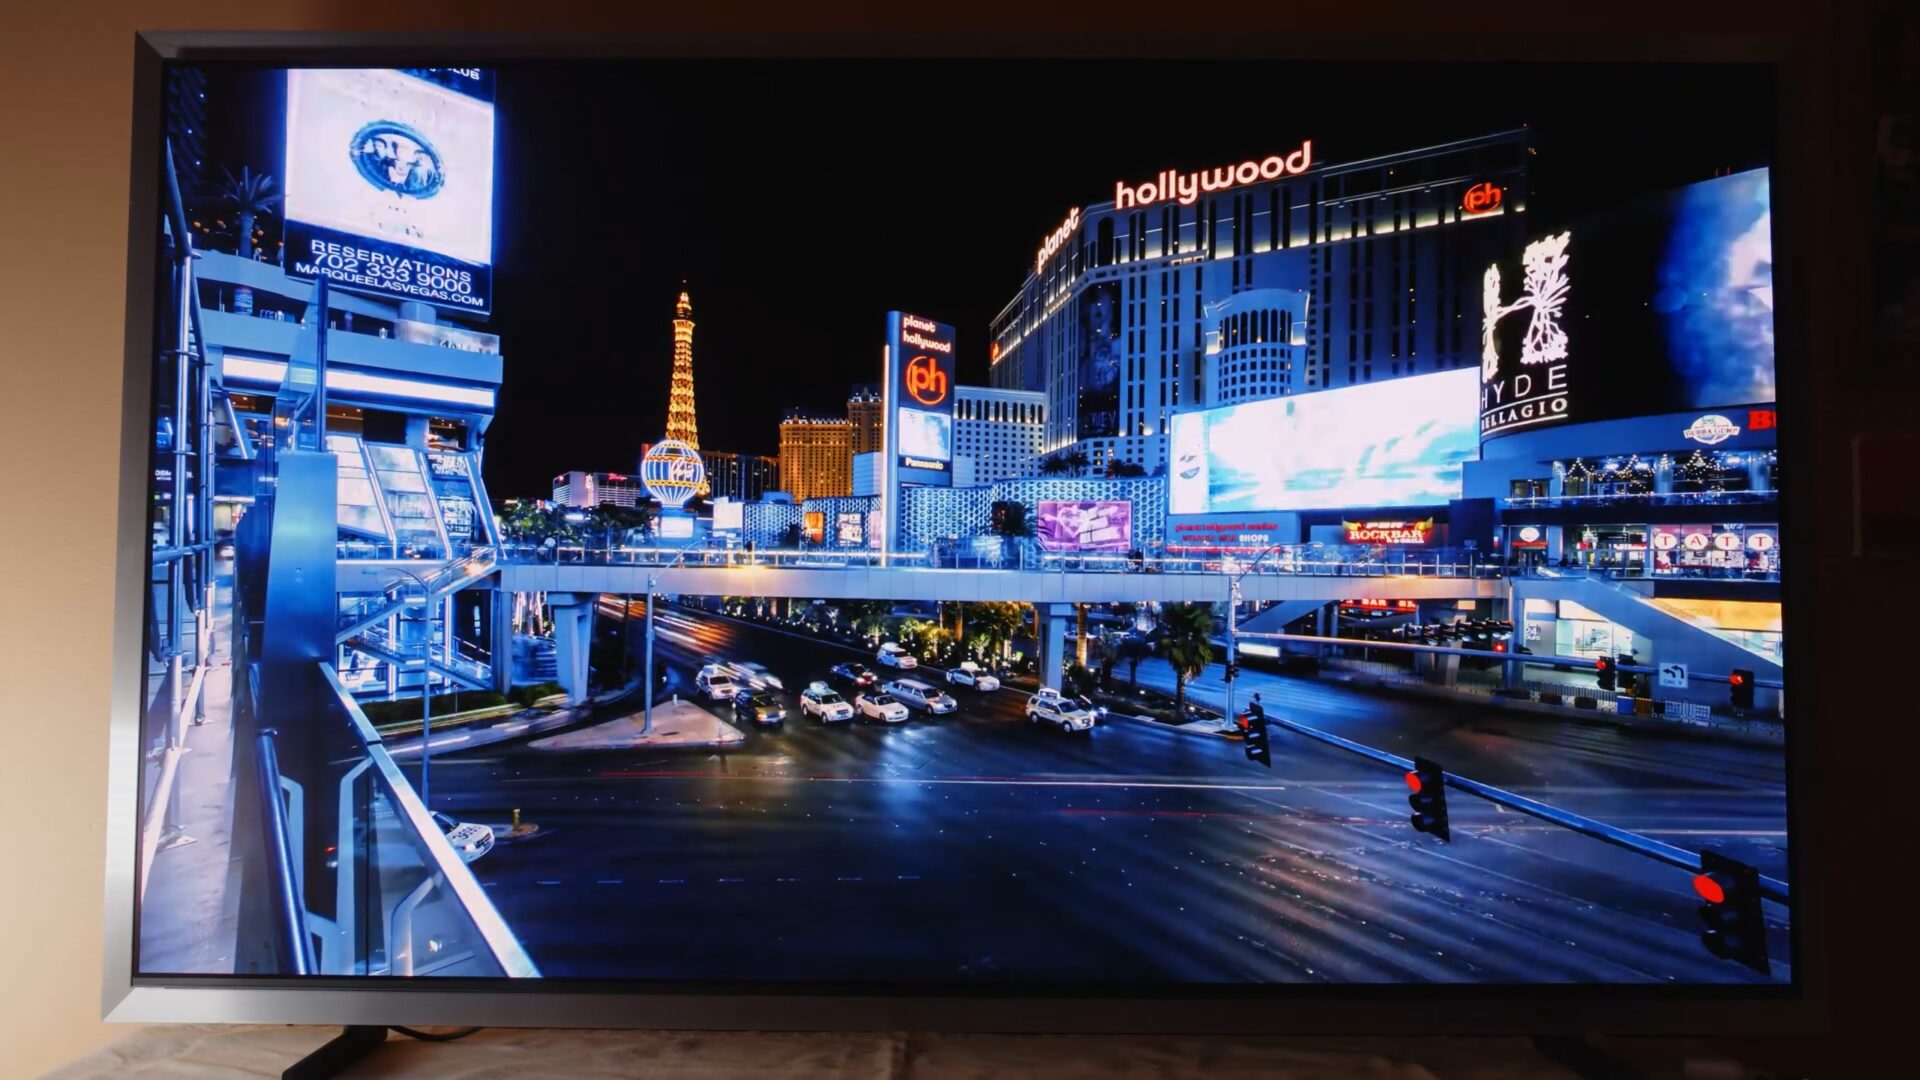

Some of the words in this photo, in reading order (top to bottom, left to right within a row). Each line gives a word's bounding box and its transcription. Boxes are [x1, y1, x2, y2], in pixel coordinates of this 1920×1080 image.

[1116, 140, 1311, 209] hollywood
[1468, 182, 1502, 211] ph
[311, 239, 471, 282] RESERVATIONS
[1038, 206, 1079, 275] planet
[295, 262, 484, 307] MARQUEELASVEGAS.COM
[312, 250, 359, 274] 702
[366, 262, 410, 283] 333
[417, 272, 471, 295] 9000
[903, 315, 936, 333] planet
[903, 331, 951, 353] hollywood
[911, 358, 946, 397] ph
[1481, 364, 1567, 411] HYDE
[905, 457, 944, 470] Panasonic
